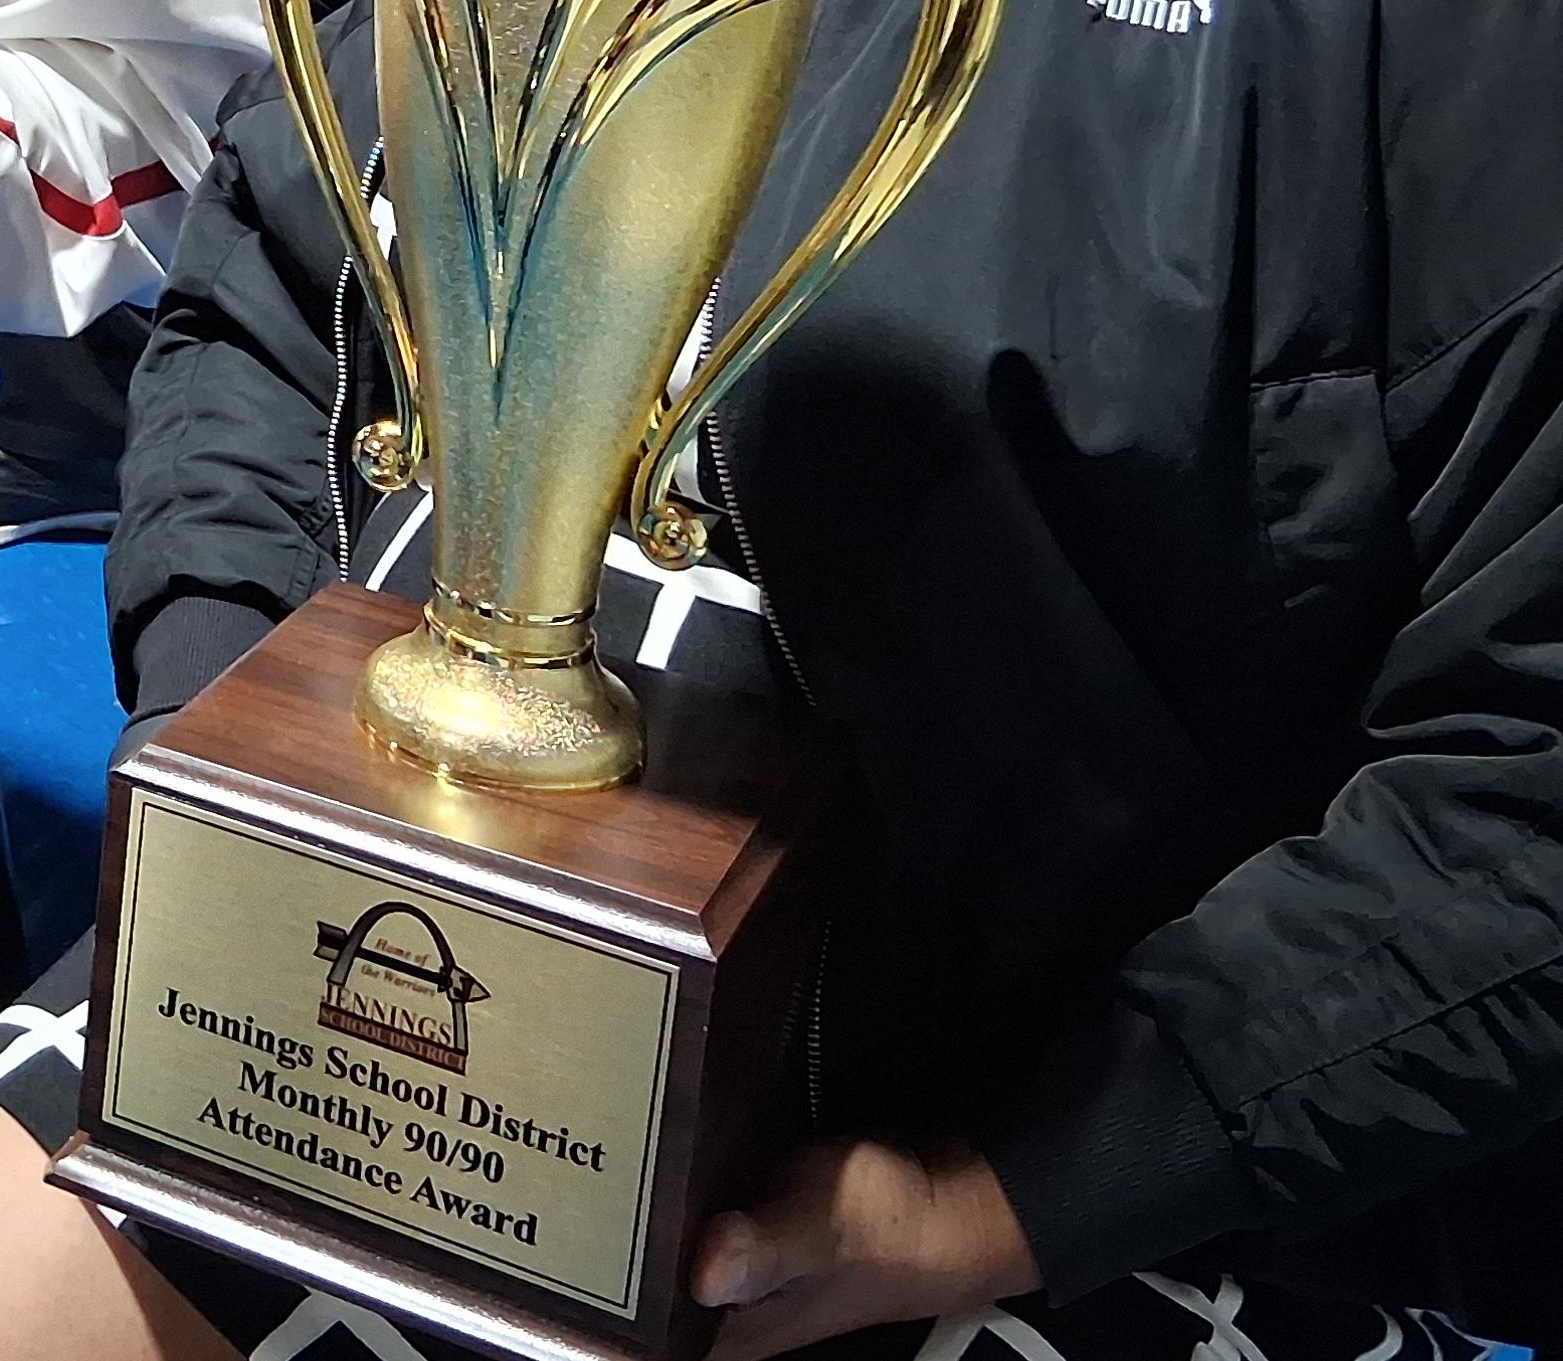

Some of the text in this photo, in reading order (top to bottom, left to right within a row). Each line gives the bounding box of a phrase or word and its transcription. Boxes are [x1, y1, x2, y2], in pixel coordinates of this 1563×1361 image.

[320, 1007, 468, 1072] SCHOOL DISTRICT
[321, 982, 453, 1049] JENNINGS
[157, 986, 607, 1173] Jennings School District
[238, 1060, 506, 1184] Monthly 90/90
[196, 1096, 539, 1246] Attendance Award
